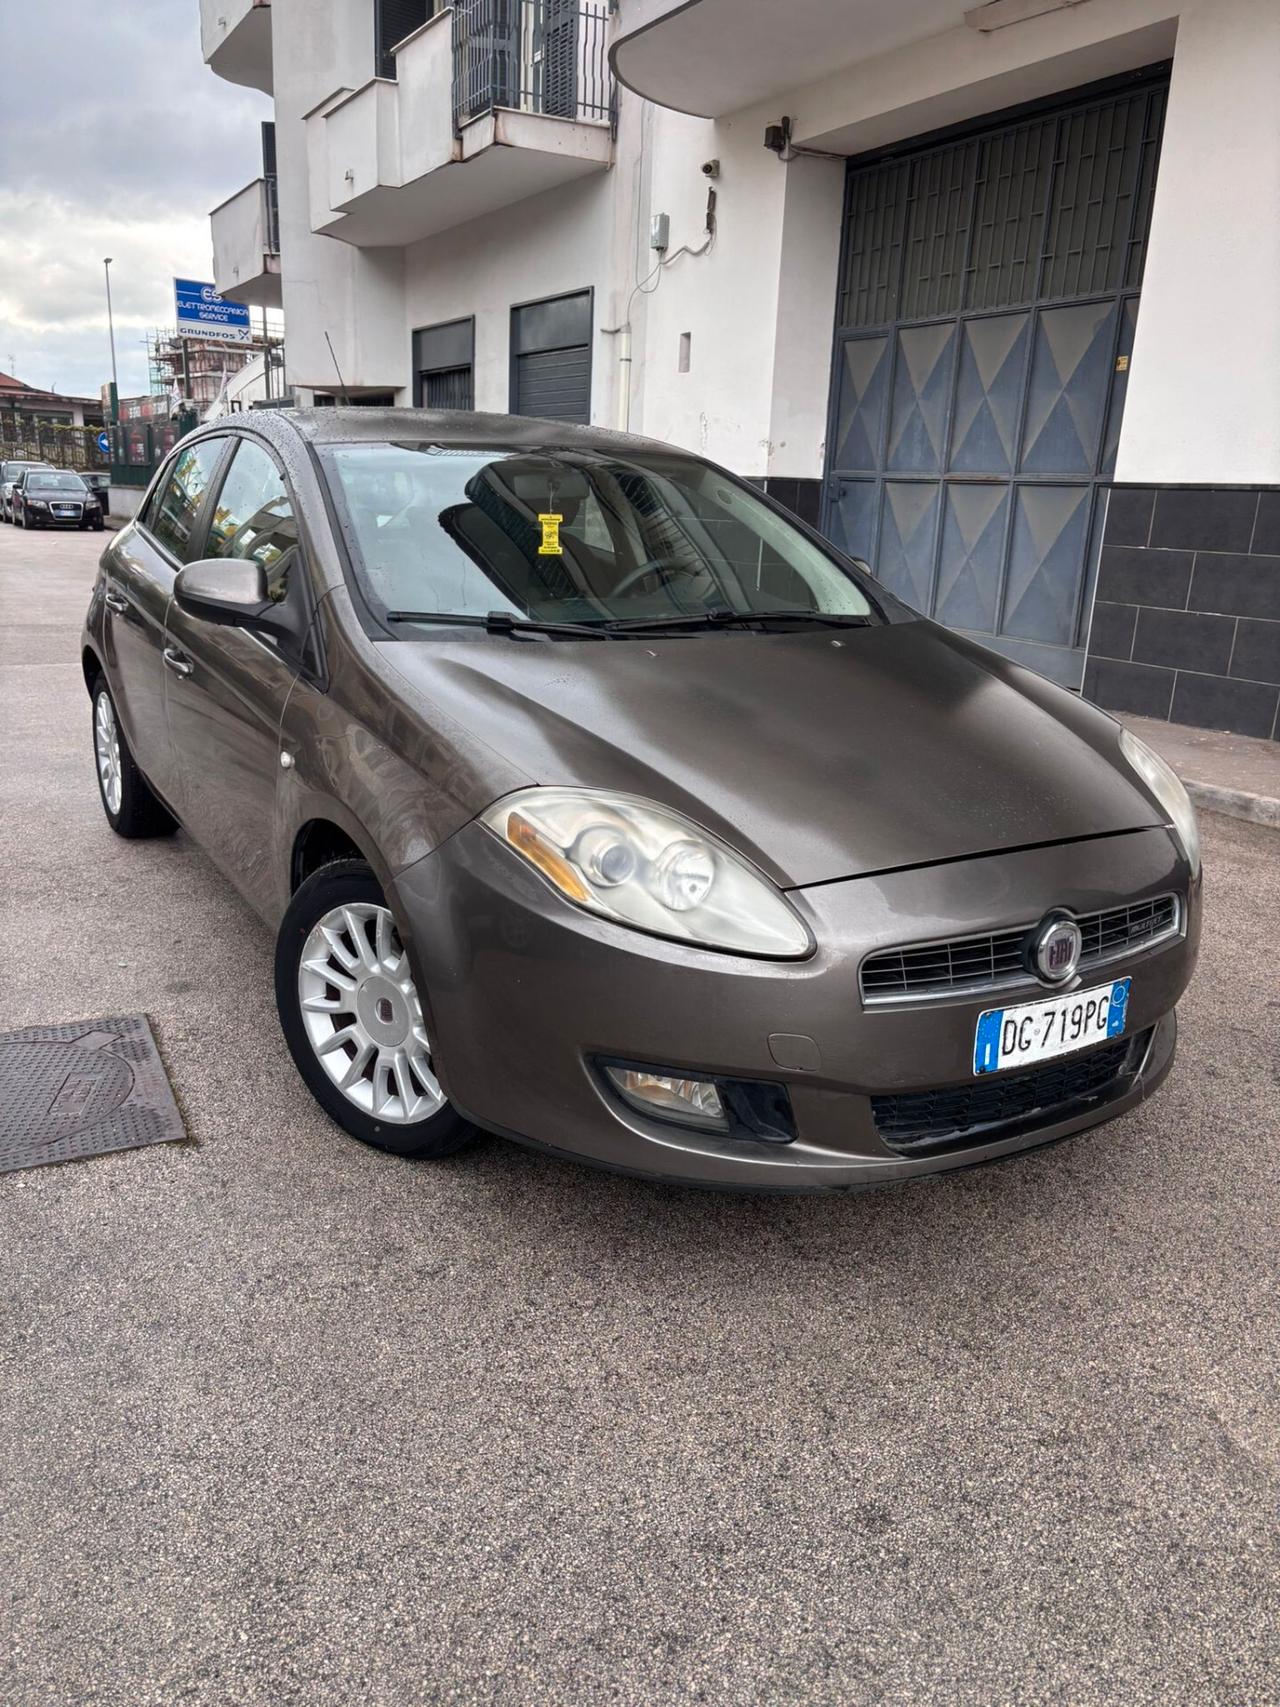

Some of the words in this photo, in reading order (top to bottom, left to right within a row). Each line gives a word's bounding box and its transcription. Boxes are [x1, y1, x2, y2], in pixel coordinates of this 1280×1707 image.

[178, 301, 248, 315] ELETTROMECCANICA
[199, 312, 228, 321] SERVICE
[180, 328, 235, 339] GRUNDFOS
